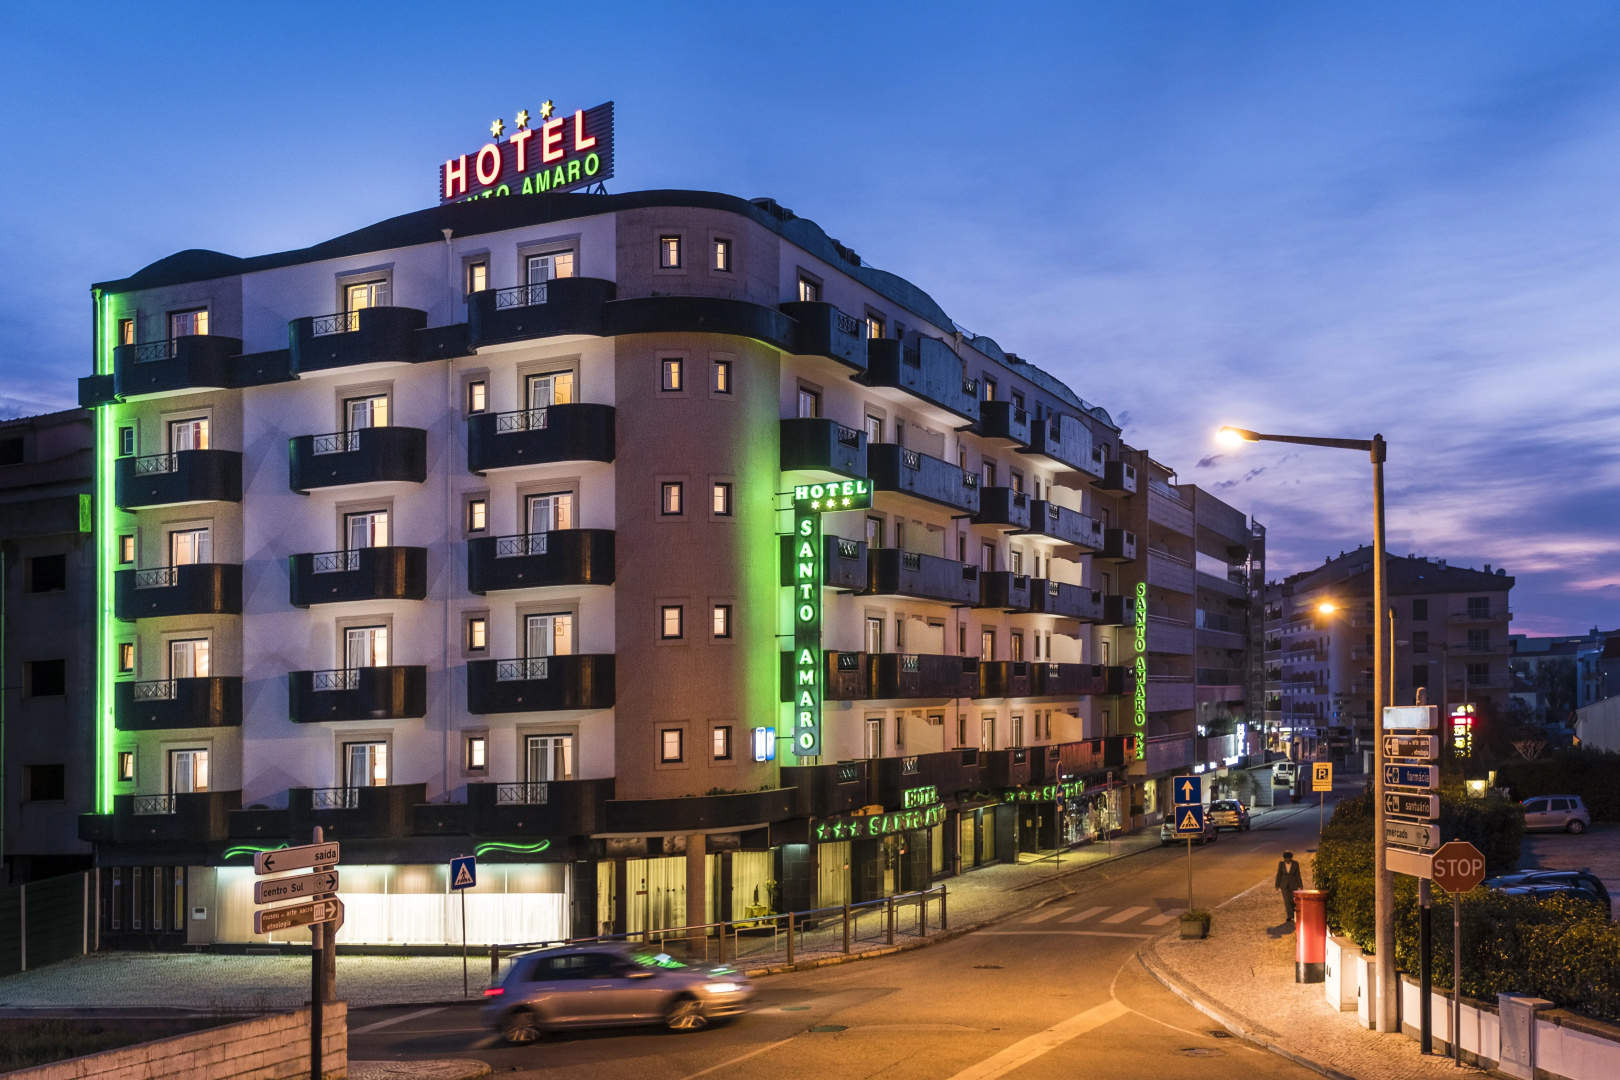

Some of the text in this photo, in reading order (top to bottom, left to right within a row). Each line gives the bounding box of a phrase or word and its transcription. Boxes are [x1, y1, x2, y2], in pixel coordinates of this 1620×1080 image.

[446, 109, 597, 198] HOTEL
[522, 152, 600, 195] AMARO
[795, 480, 868, 500] HOTEL
[799, 519, 815, 750] SANTO AMARO
[1135, 582, 1146, 726] SANTO AMARO
[1406, 771, 1429, 782] farmácia
[1405, 801, 1430, 813] santuário
[1387, 828, 1408, 839] mercado
[1434, 858, 1483, 877] STOP
[263, 882, 304, 897] centro Sul
[262, 913, 280, 921] museu
[299, 906, 313, 914] sacra
[267, 920, 291, 931] etnologia
